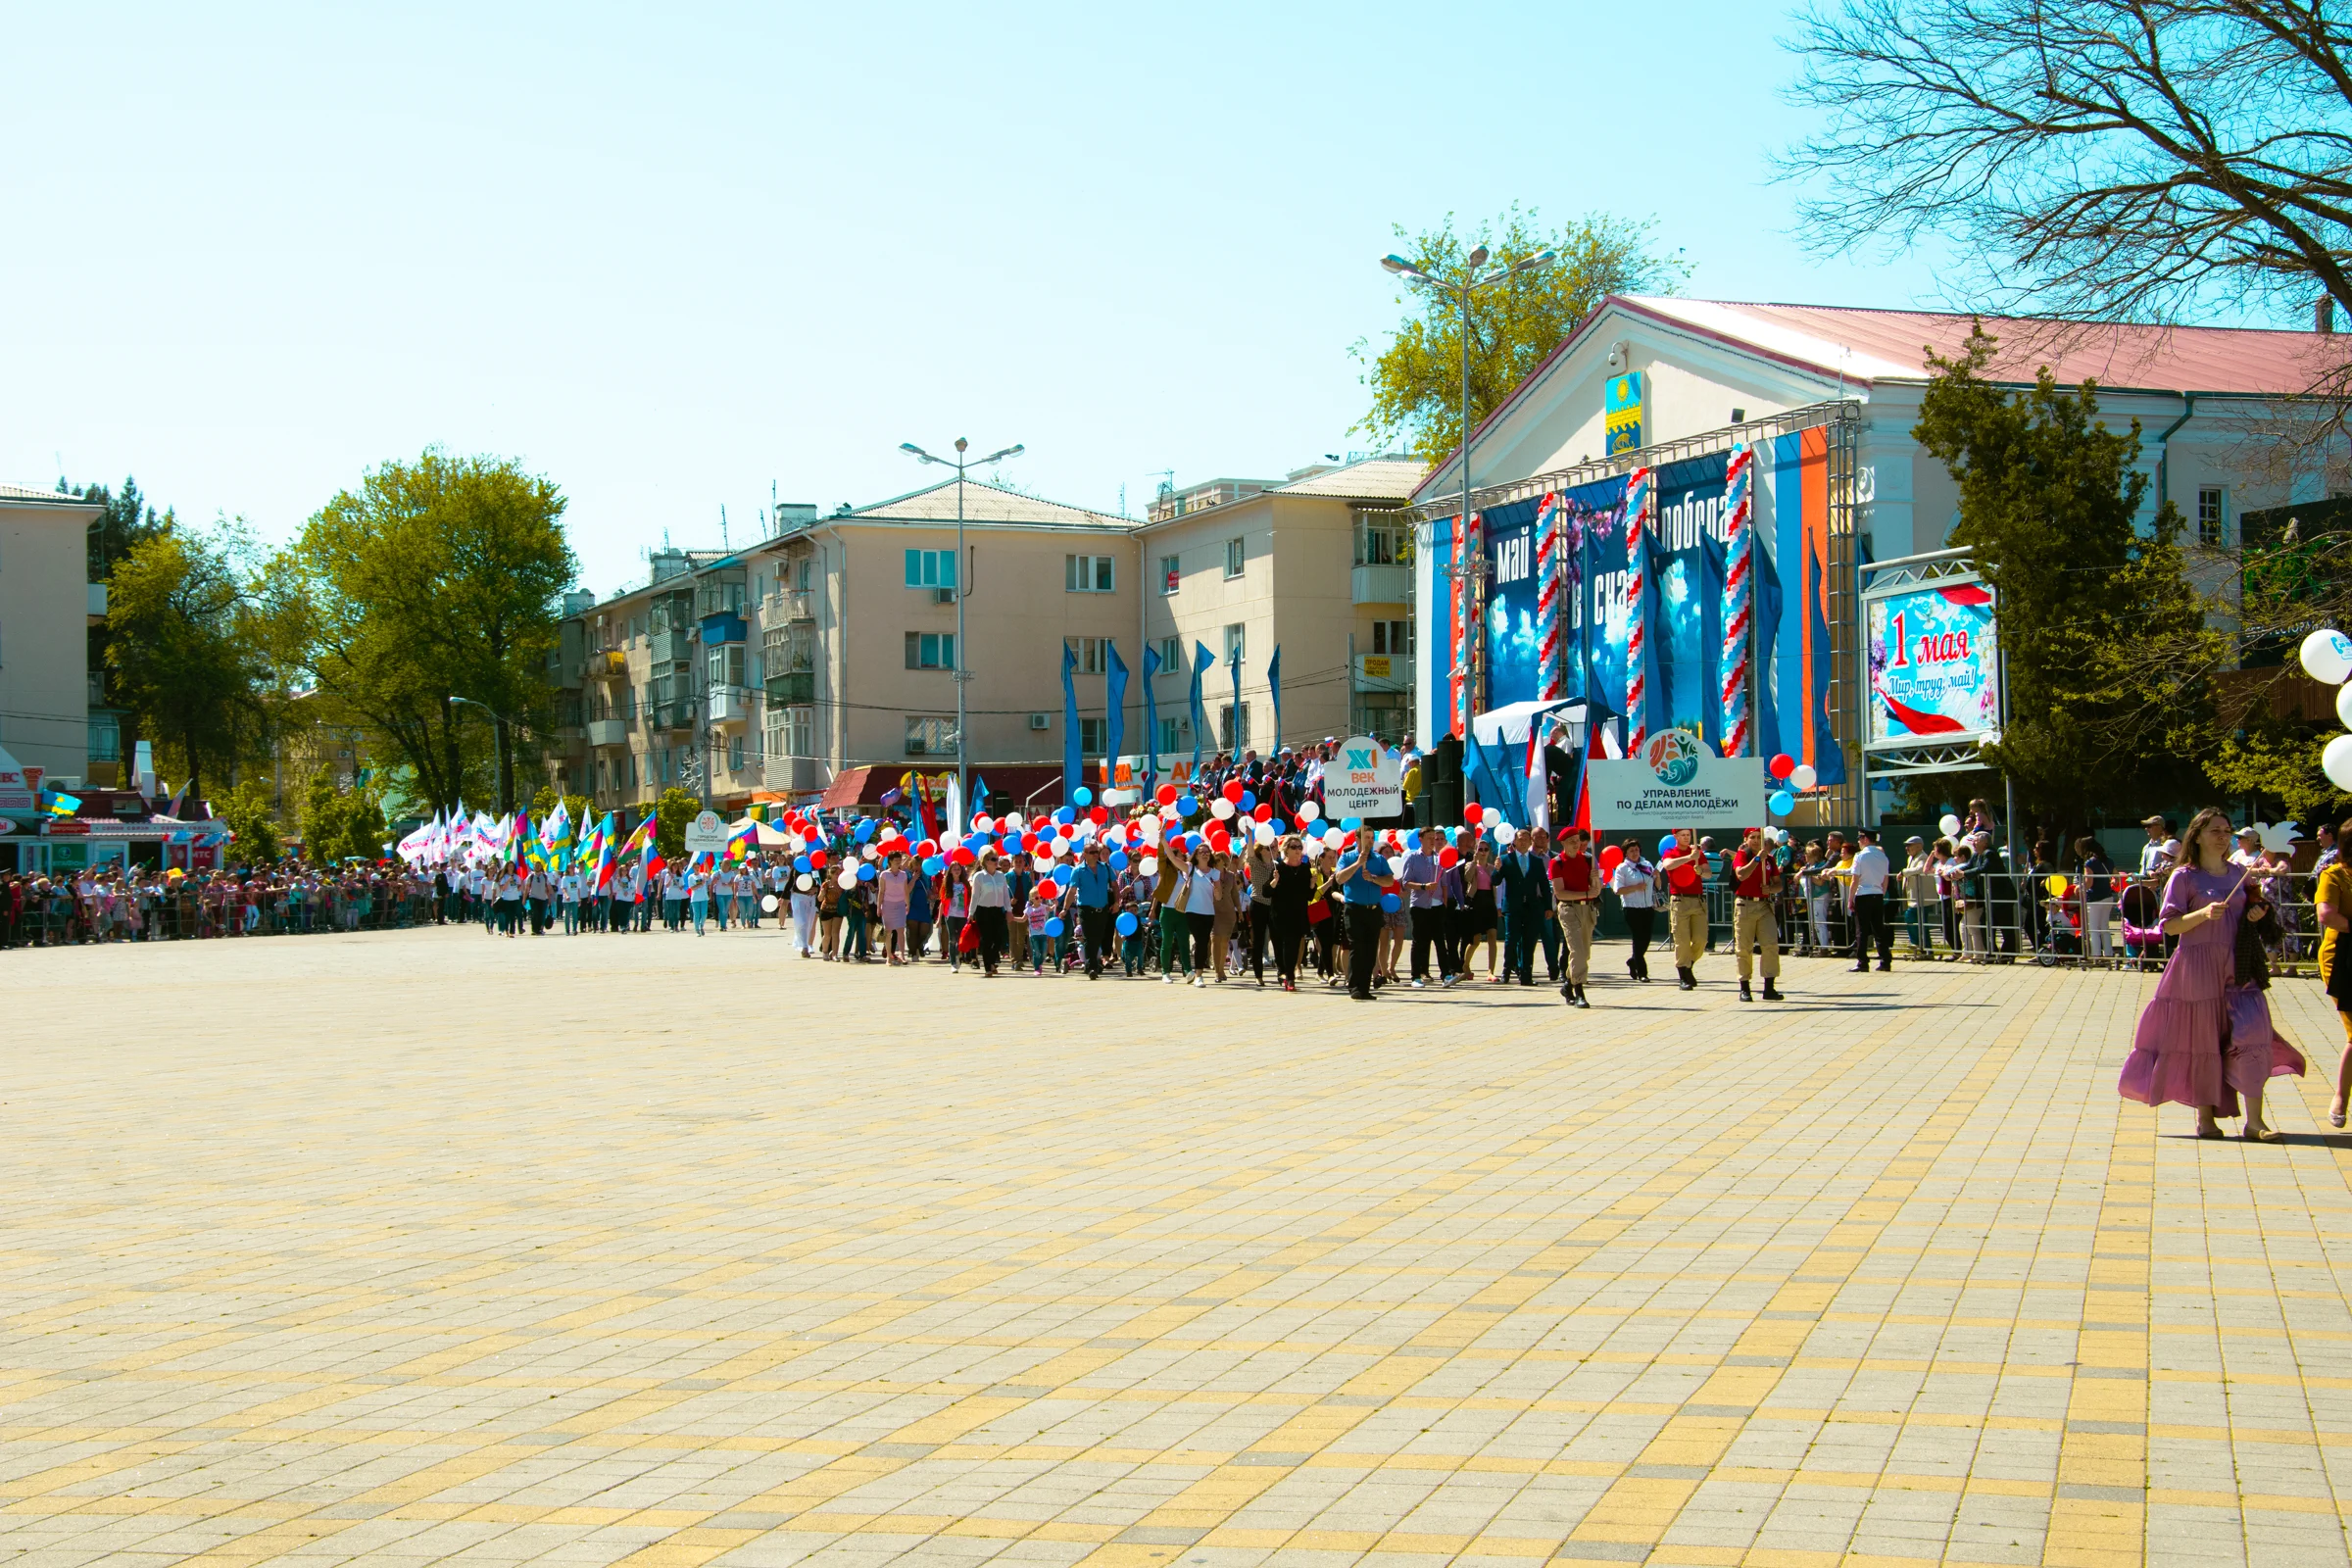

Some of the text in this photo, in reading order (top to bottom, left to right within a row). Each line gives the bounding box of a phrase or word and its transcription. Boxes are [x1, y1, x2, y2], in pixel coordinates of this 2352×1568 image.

[1496, 526, 1530, 585] май
[1892, 612, 1971, 666] 1 мая
[1888, 668, 1976, 700] Мир, труд, май!
[1327, 785, 1399, 797] МОЛОДЕЖНЫЙ
[1642, 789, 1712, 799] УПРАВЛЕНИЕ
[1348, 799, 1380, 810] ЦЕНТР
[1617, 797, 1739, 810] ПО ДЕЛАМ МОЛОДЁЖИ
